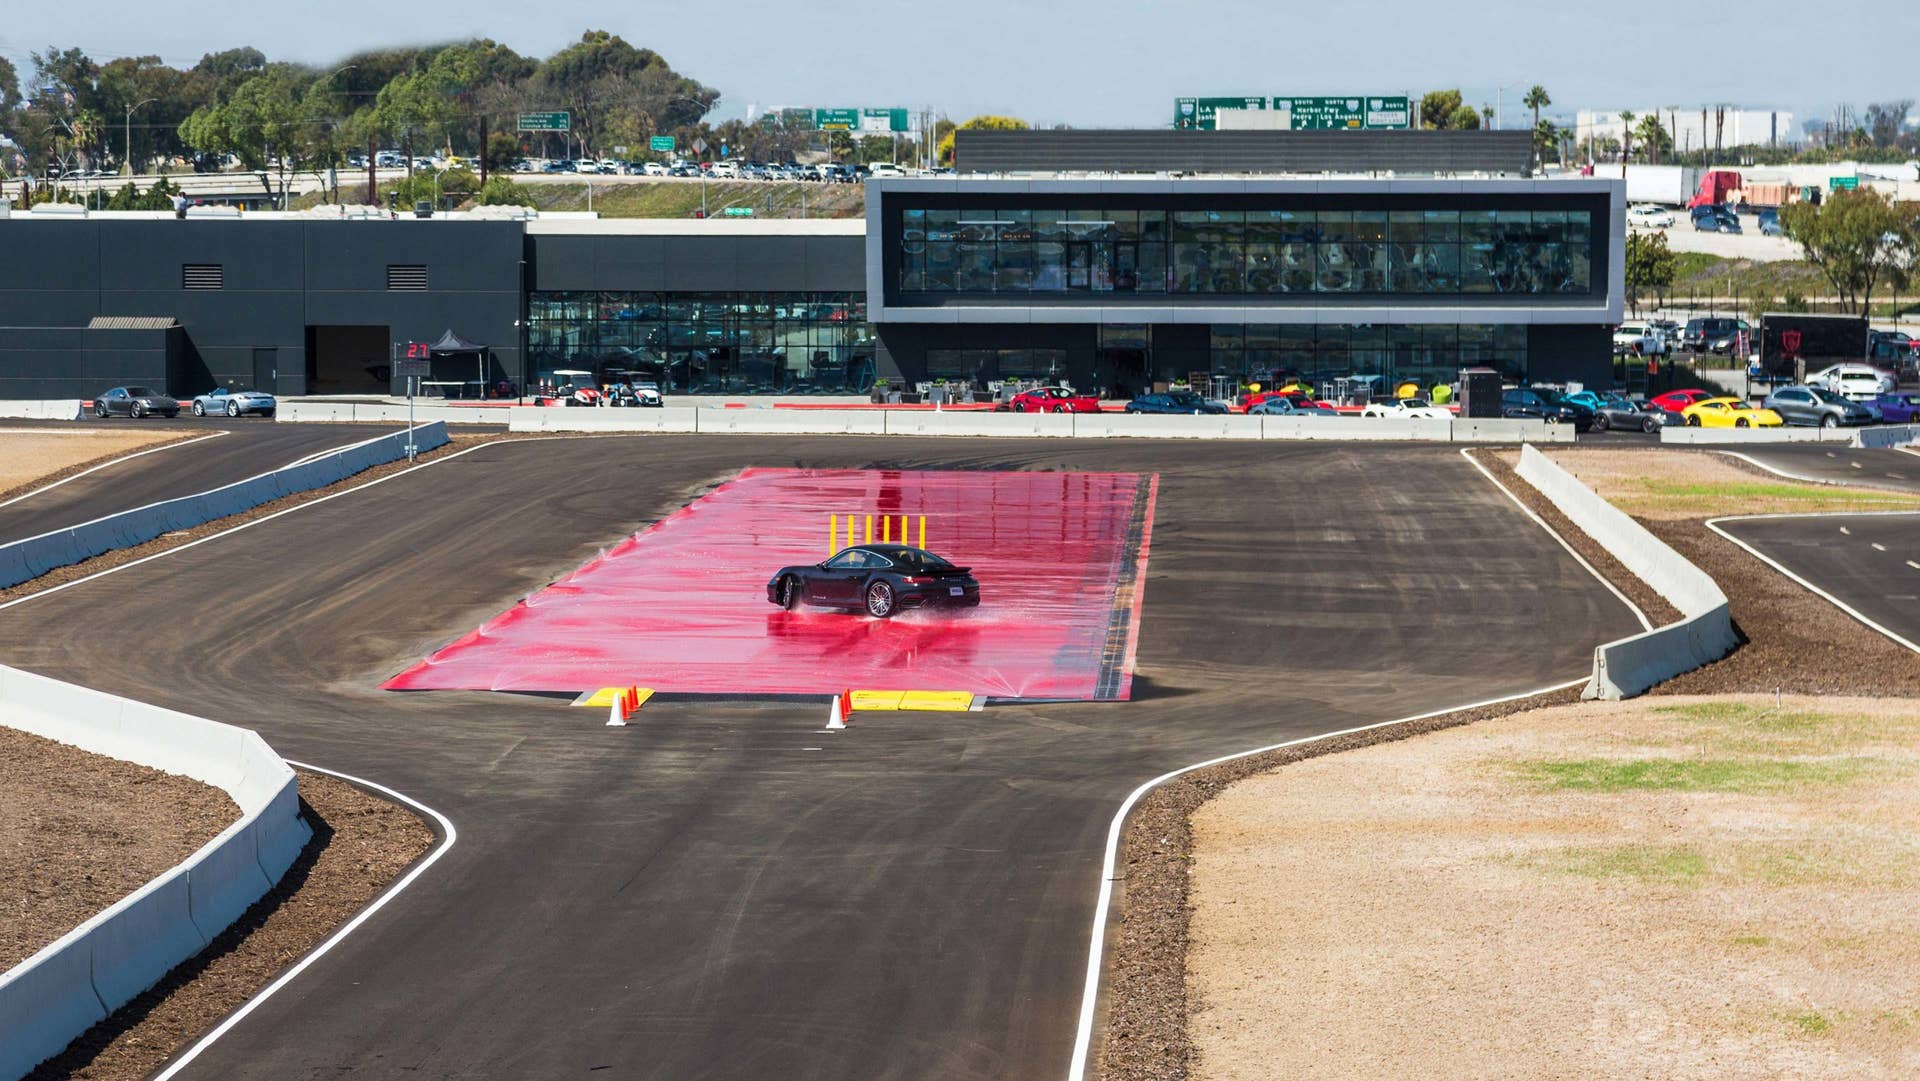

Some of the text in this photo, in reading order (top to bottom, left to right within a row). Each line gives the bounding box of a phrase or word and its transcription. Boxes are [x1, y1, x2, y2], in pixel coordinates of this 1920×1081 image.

[1324, 106, 1339, 115] Fwy
[1334, 113, 1362, 121] Angeles
[407, 343, 428, 358] 27
